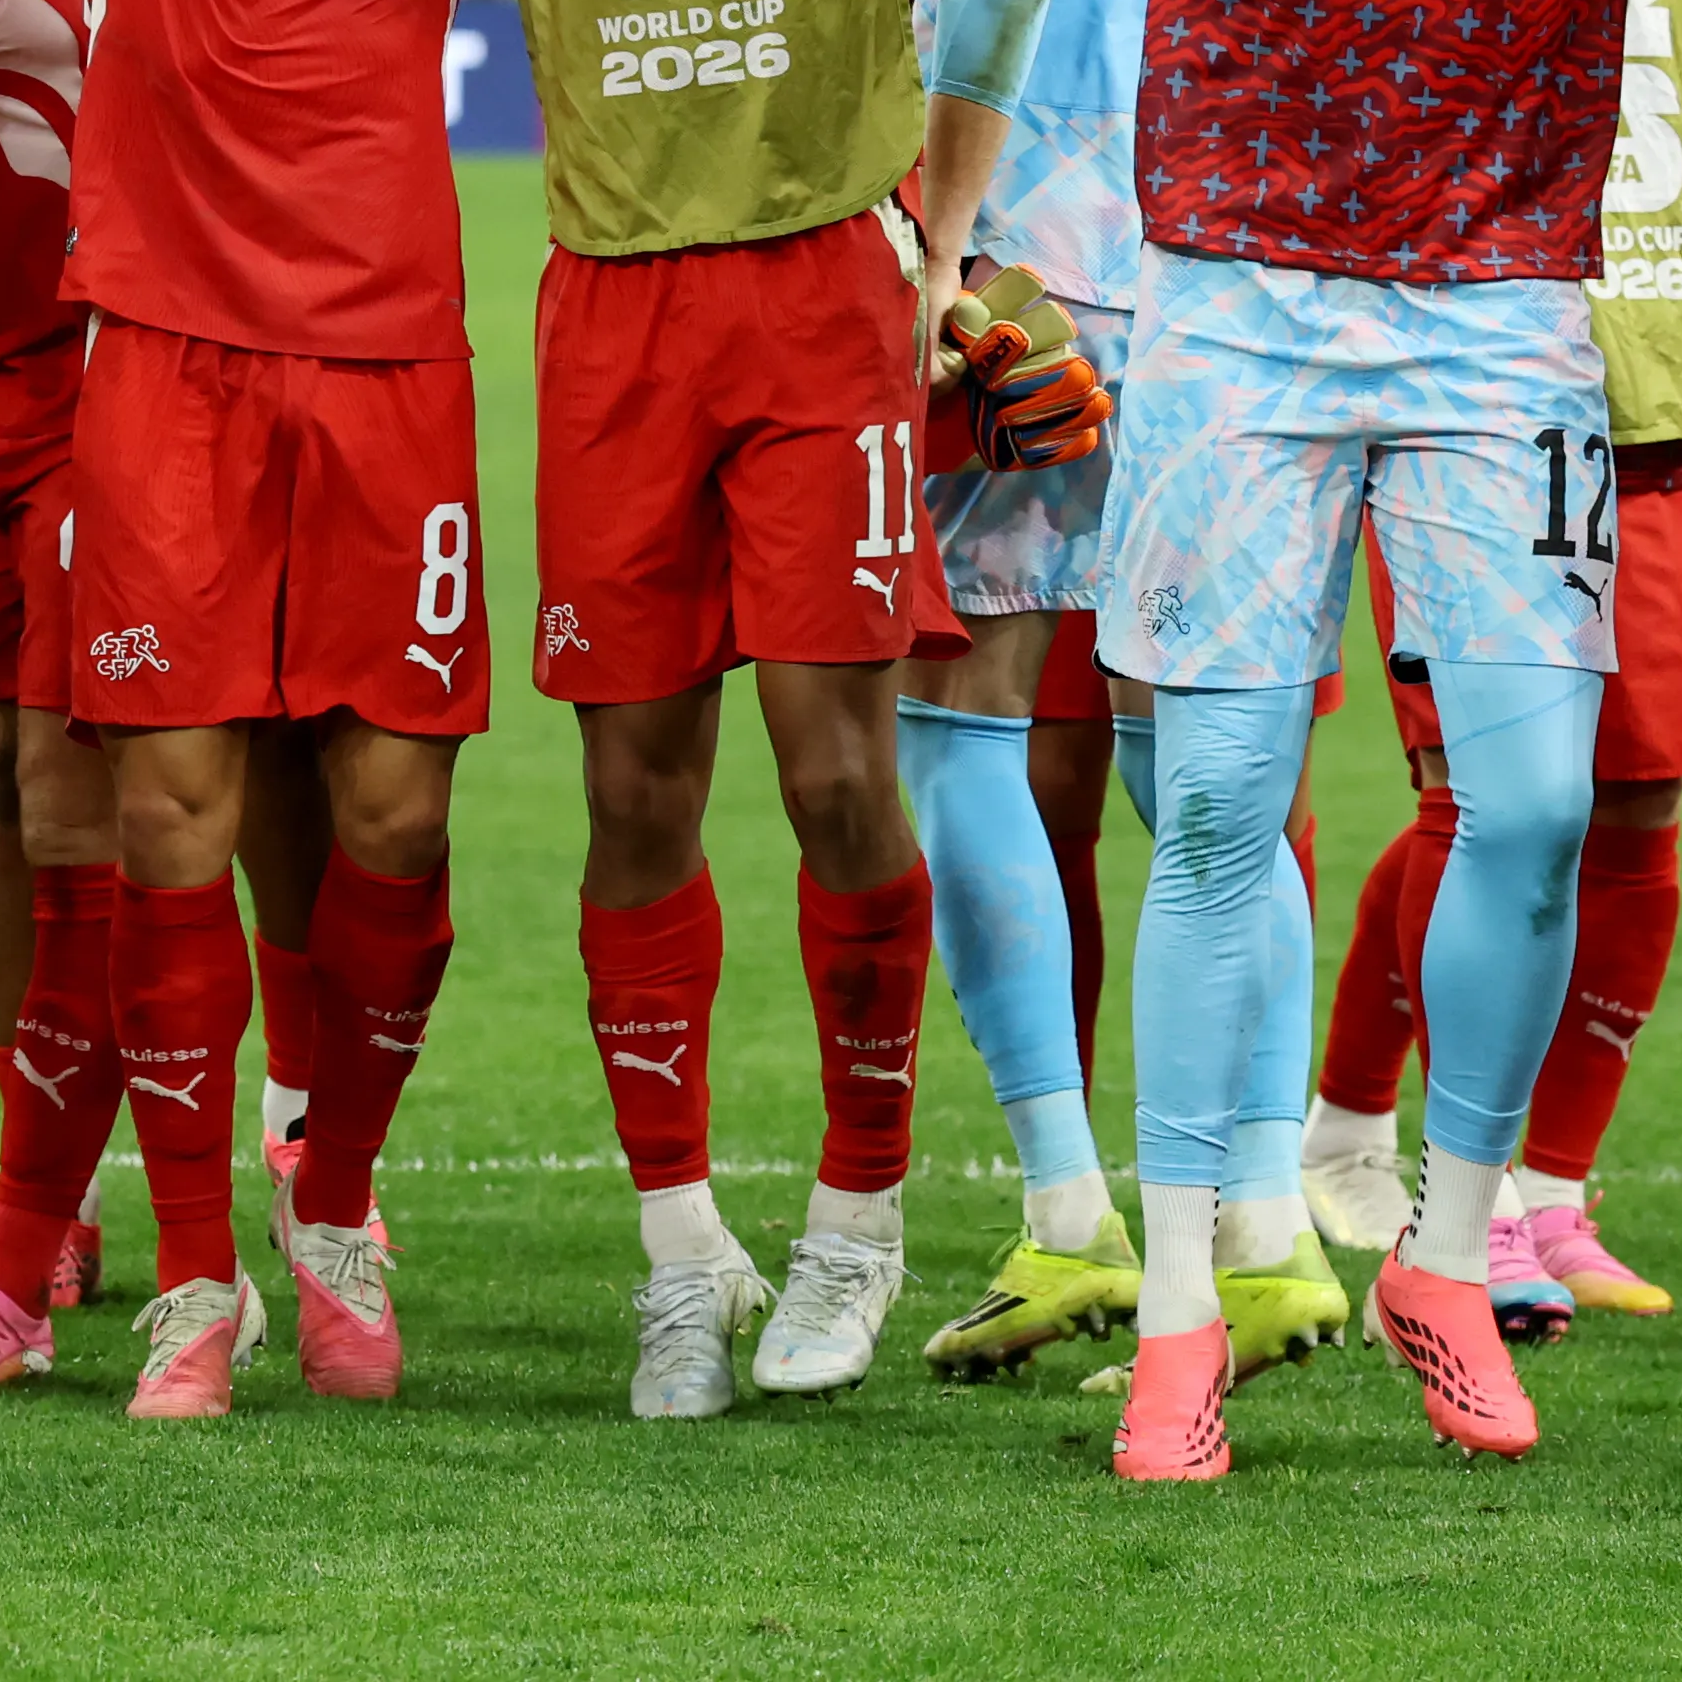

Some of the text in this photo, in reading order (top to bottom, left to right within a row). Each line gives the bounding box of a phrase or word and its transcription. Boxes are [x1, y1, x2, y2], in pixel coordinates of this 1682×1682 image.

[597, 7, 714, 45] WORLD
[601, 32, 790, 97] 2026
[1608, 154, 1644, 183] FA
[854, 421, 915, 558] 11
[1531, 428, 1615, 564] 12
[416, 501, 469, 636] 8
[598, 1020, 689, 1035] suisse
